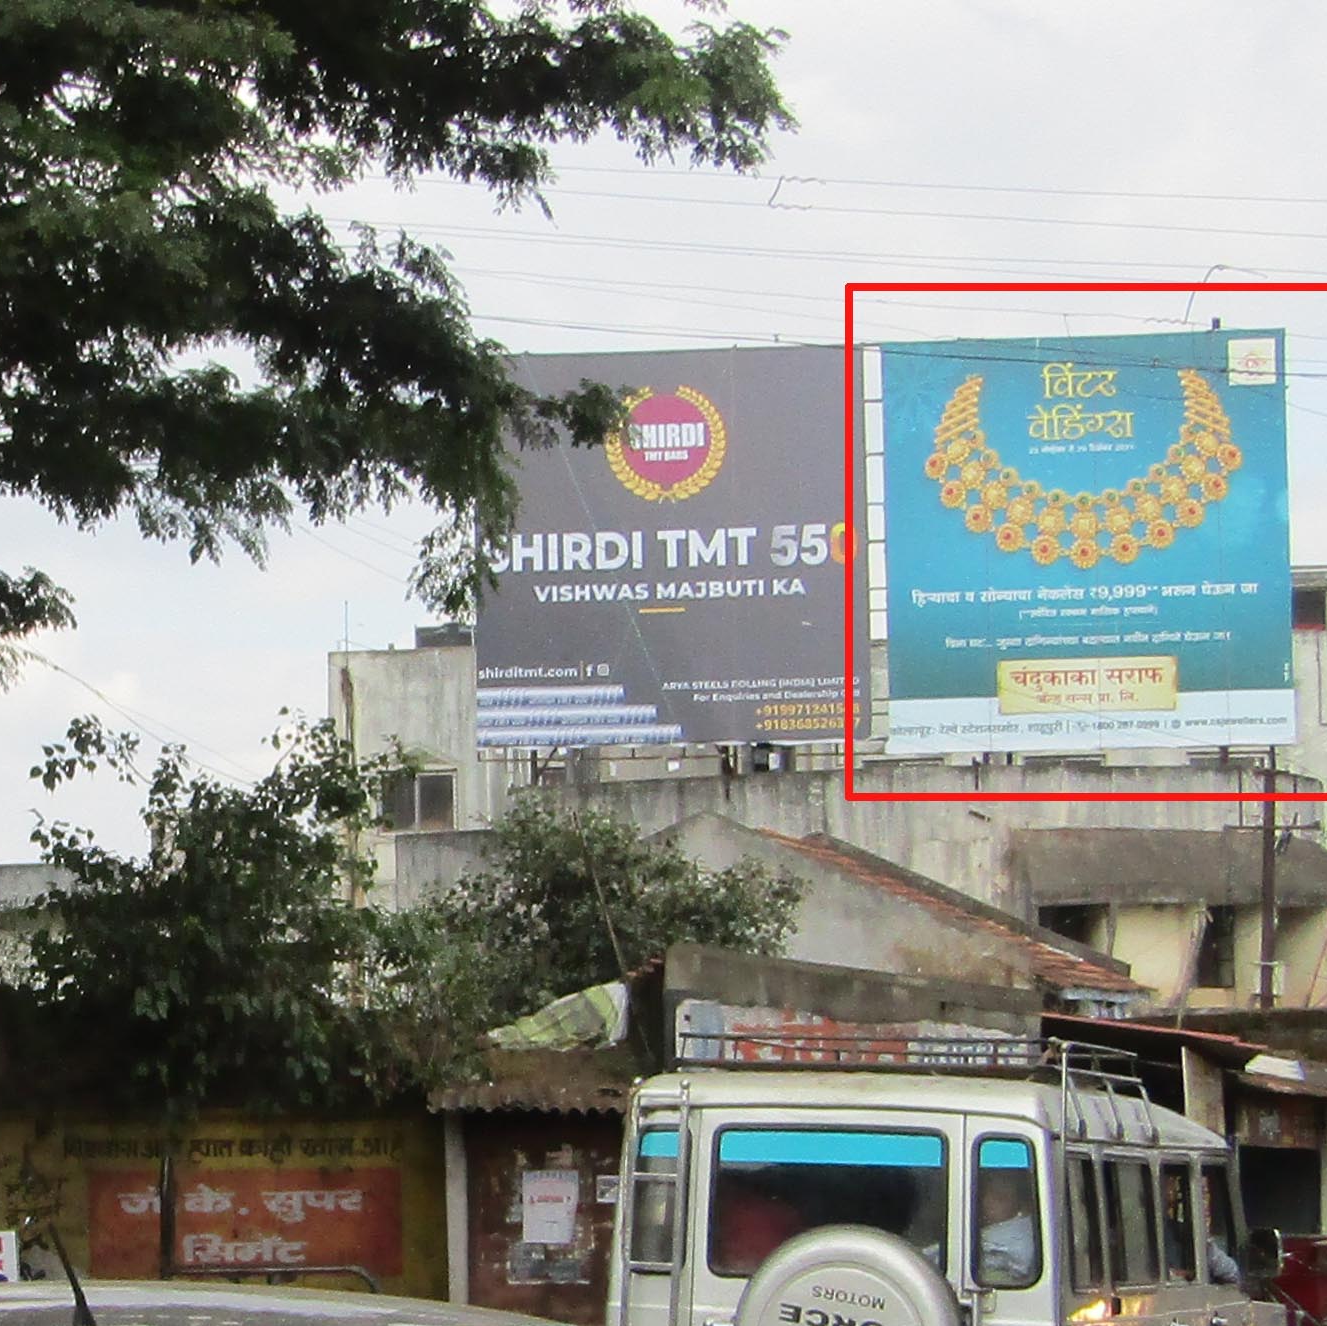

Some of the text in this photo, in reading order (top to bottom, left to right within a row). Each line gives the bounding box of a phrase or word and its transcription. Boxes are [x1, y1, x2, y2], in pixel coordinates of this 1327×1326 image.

[1040, 362, 1118, 398] विंटर
[1026, 403, 1134, 441] वेडिंग्स
[629, 422, 705, 450] SHIRDI
[644, 451, 662, 462] TMT
[656, 526, 757, 568] TMT
[534, 577, 806, 603] VISHWAS MAJBUTI KA
[478, 666, 578, 680] shirditmt.com
[817, 676, 860, 687] LIMITD
[1105, 667, 1163, 685] सराफ
[693, 693, 710, 702] For
[261, 1189, 365, 1224] सुपर
[812, 1285, 886, 1310] MOTORS
